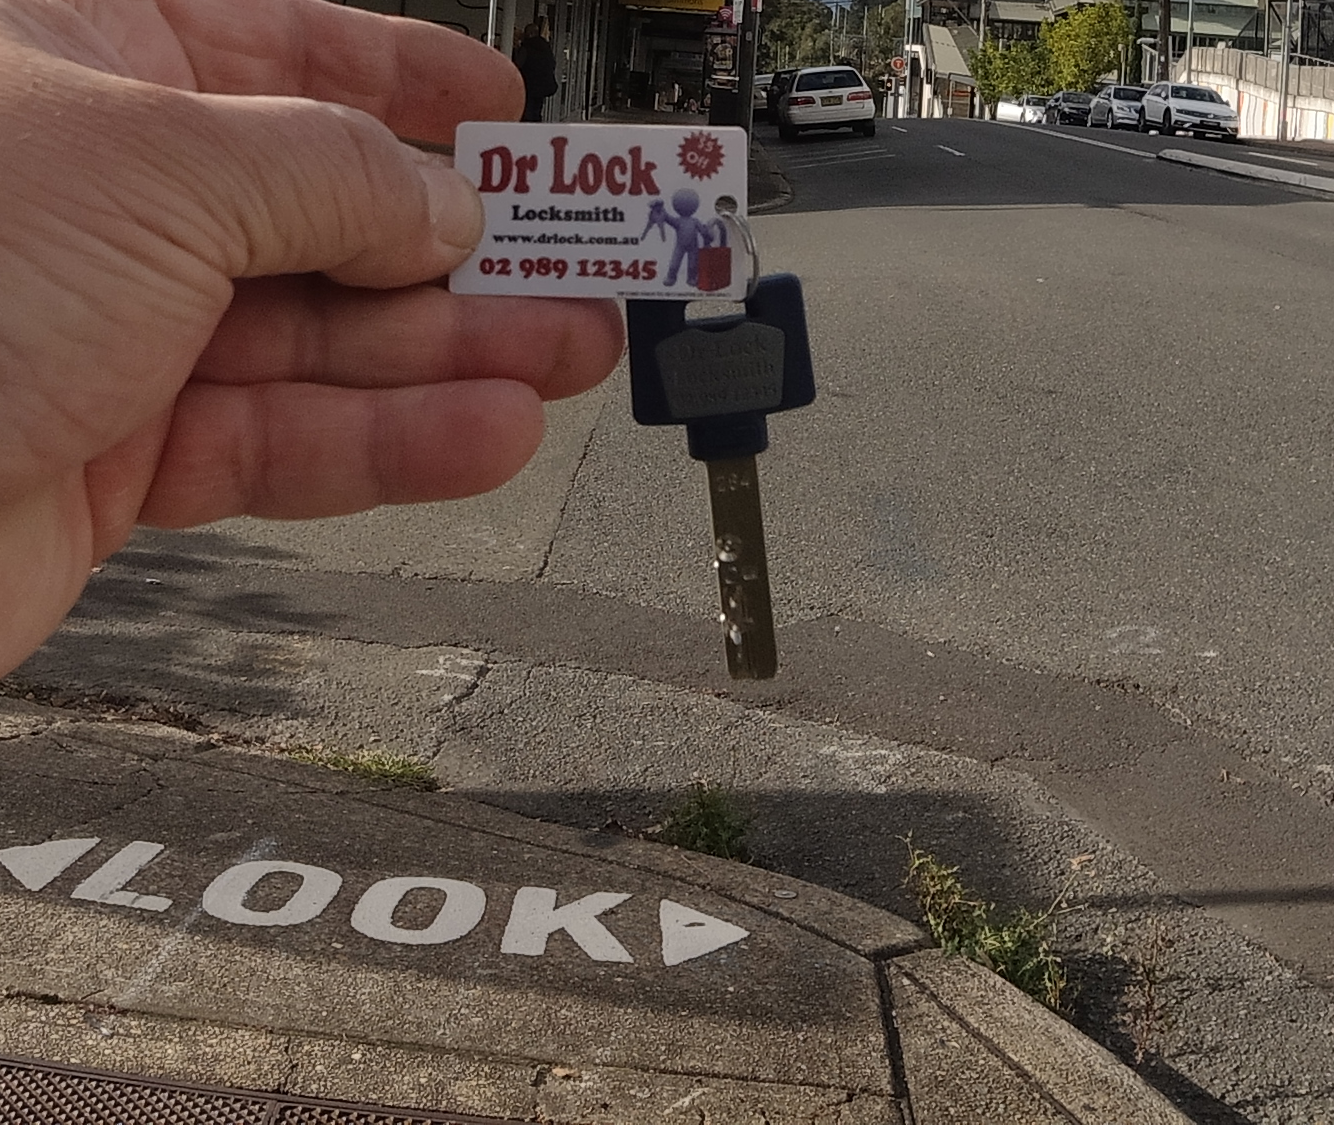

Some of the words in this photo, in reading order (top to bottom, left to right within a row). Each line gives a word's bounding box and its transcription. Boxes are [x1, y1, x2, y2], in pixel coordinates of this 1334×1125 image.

[478, 145, 538, 194] Dr
[550, 136, 661, 196] Lock
[511, 204, 625, 223] Locksmith
[492, 232, 640, 246] www.drlock.com.au
[479, 257, 512, 276] 02
[519, 257, 568, 279] 989
[577, 258, 658, 281] 12345
[70, 840, 635, 964] LOOK
